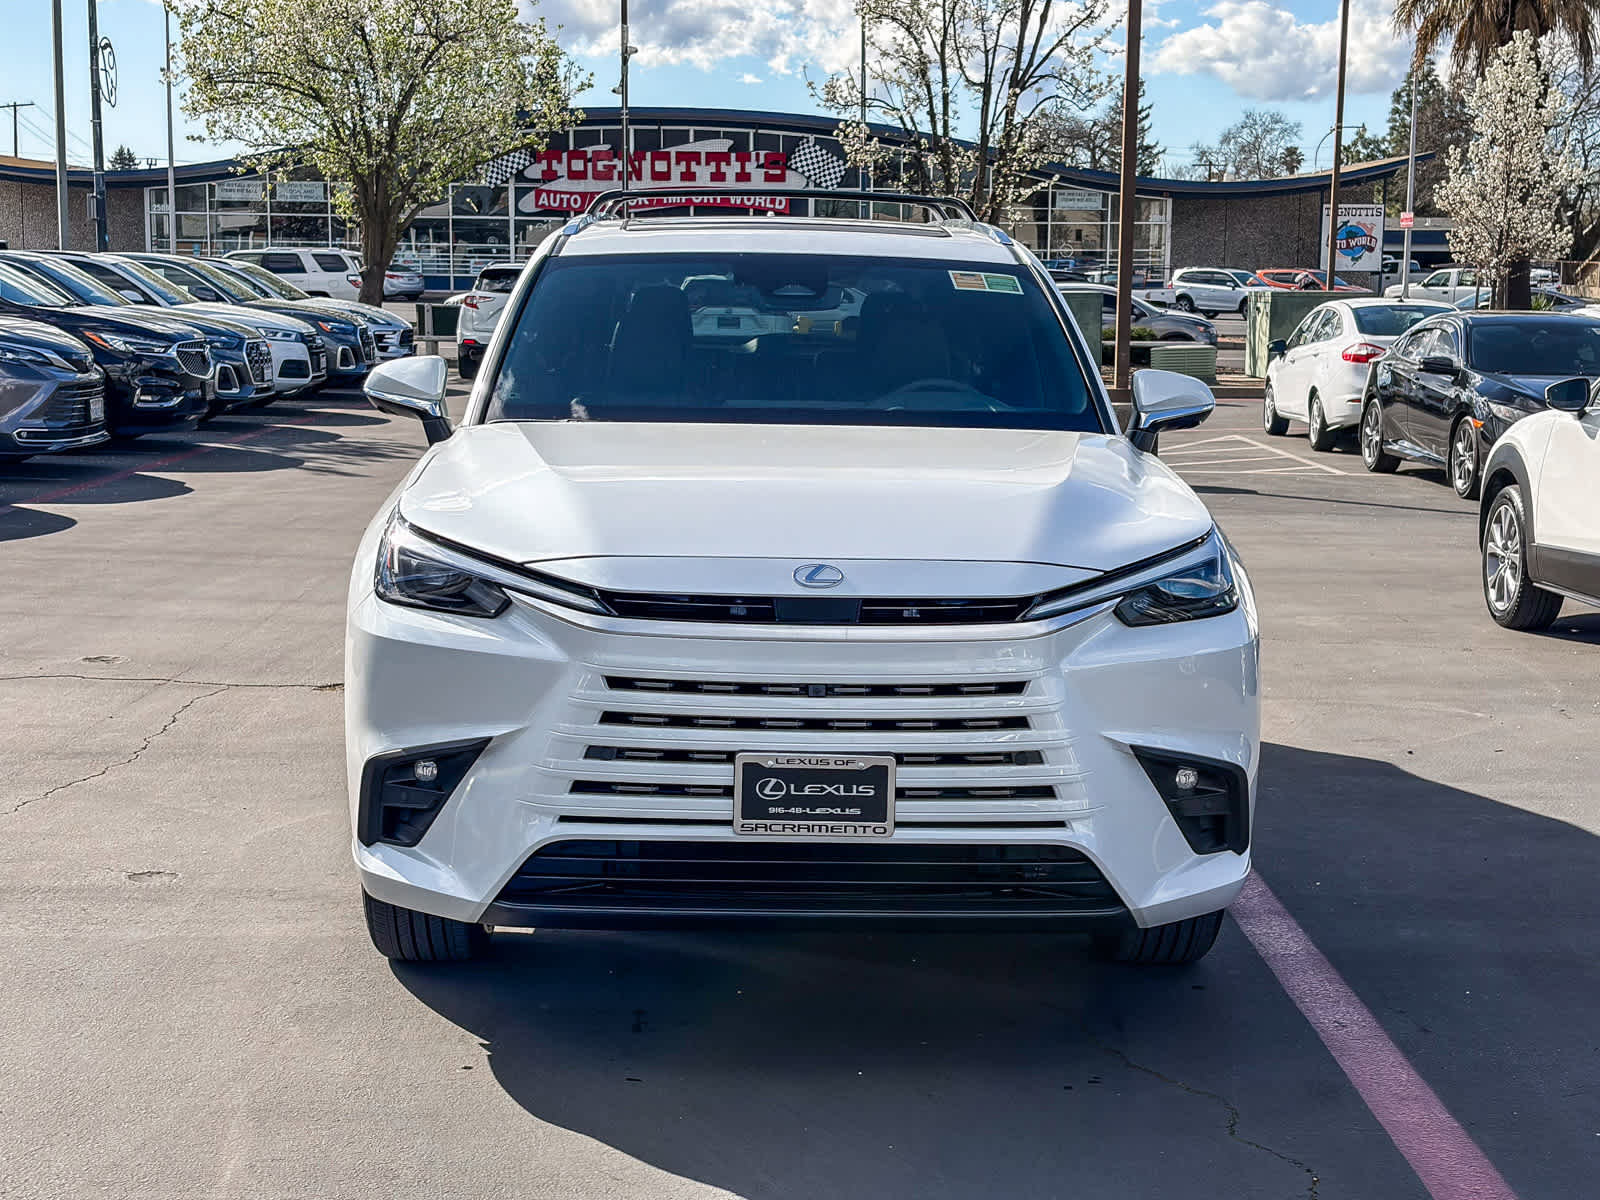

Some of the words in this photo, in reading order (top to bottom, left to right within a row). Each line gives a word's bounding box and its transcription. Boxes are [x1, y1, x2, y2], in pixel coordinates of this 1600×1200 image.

[536, 150, 787, 182] TOGNOTTI'S
[538, 192, 582, 208] AUTO
[729, 197, 786, 210] WORLD
[1348, 236, 1376, 248] WORLD
[775, 758, 829, 766] LEXUS
[790, 784, 876, 796] LEXUS
[740, 823, 888, 835] SACRAMENTO
